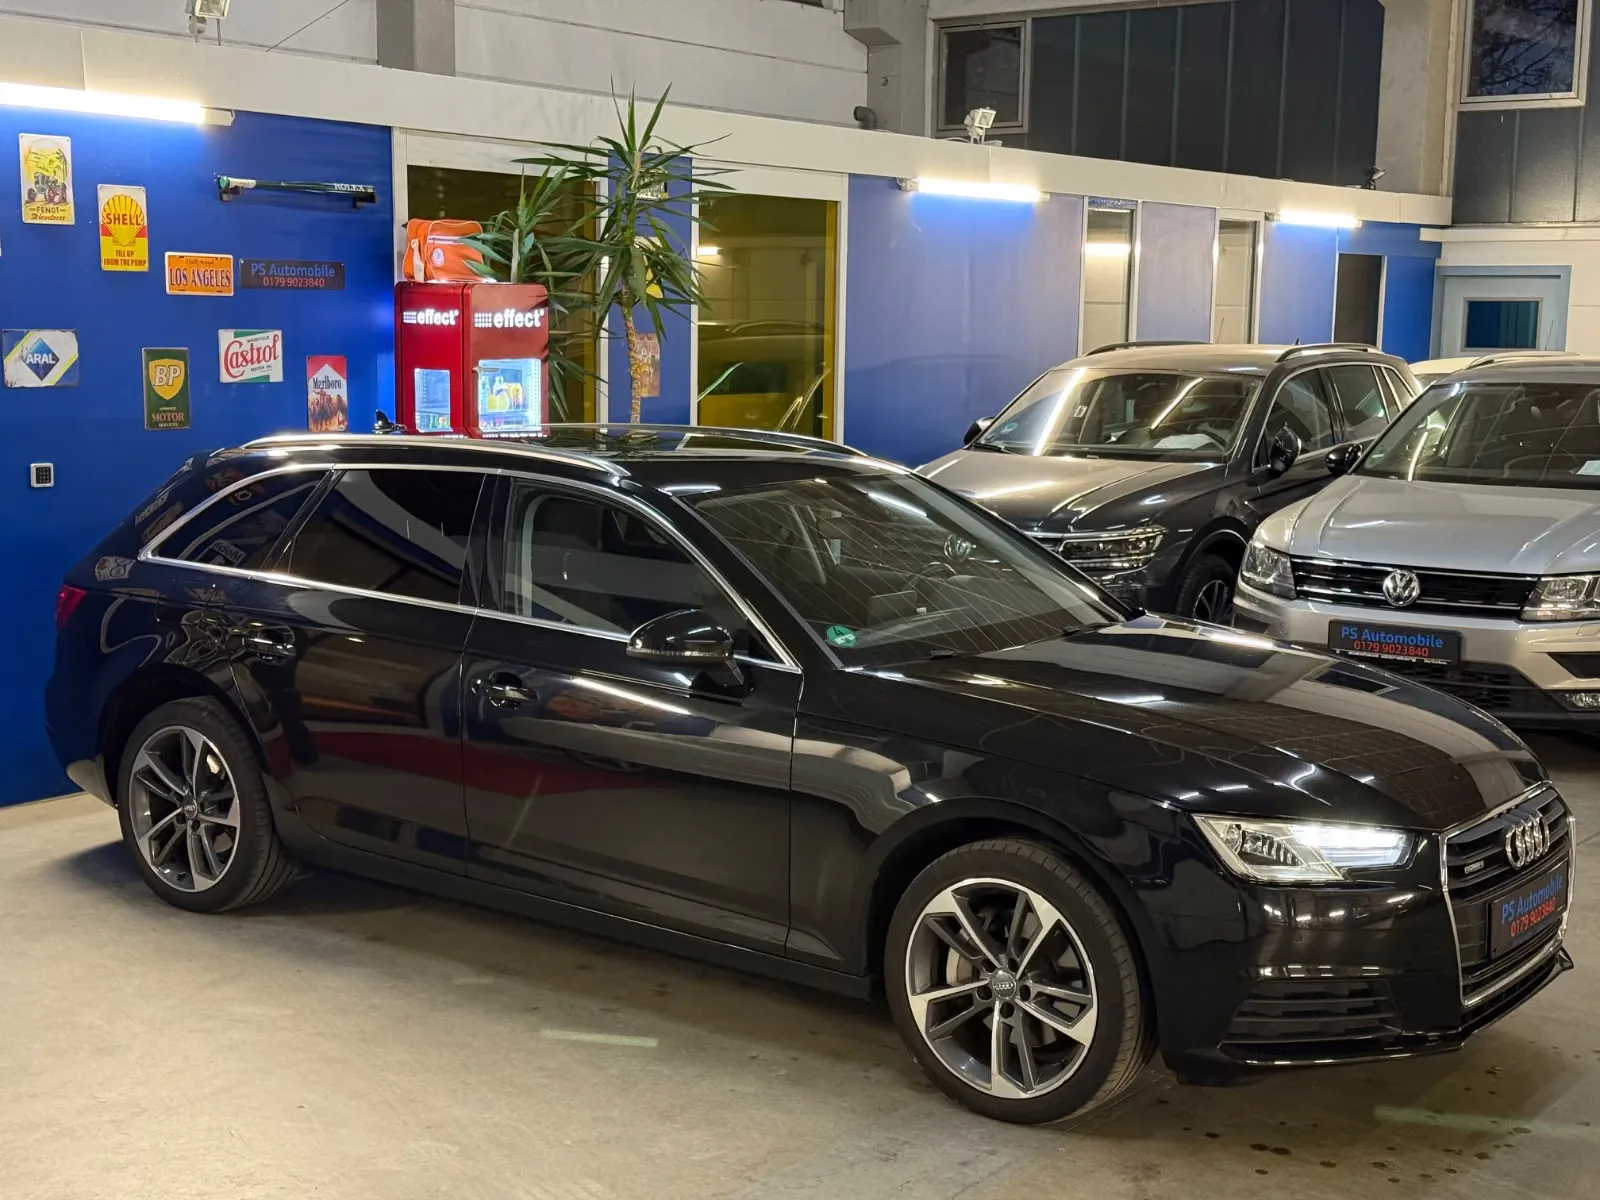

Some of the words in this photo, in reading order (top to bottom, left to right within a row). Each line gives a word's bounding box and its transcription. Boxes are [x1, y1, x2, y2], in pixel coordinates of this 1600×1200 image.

[36, 206, 60, 214] FENDT
[105, 212, 142, 226] SHELL
[115, 249, 126, 257] FILL
[103, 258, 119, 266] FROM
[130, 259, 147, 267] PUMP
[170, 268, 188, 287] LOS
[191, 268, 231, 289] ANGELES
[251, 263, 266, 276] PS
[269, 264, 335, 279] Automobile
[263, 276, 286, 288] 0179
[287, 276, 325, 288] 9023840
[417, 309, 457, 326] effect
[493, 308, 542, 329] effect
[26, 353, 56, 365] ARAL
[223, 333, 280, 379] Castrol
[154, 364, 182, 387] BP
[312, 375, 342, 390] Marlboro
[151, 412, 185, 423] MOTOR
[1341, 626, 1359, 640] PS
[1361, 628, 1444, 649] Automobile
[1353, 640, 1380, 653] 0179
[1382, 643, 1429, 658] 9023840
[1502, 899, 1515, 924] PS
[1517, 872, 1563, 914] Automobile
[1510, 914, 1528, 937] 0179
